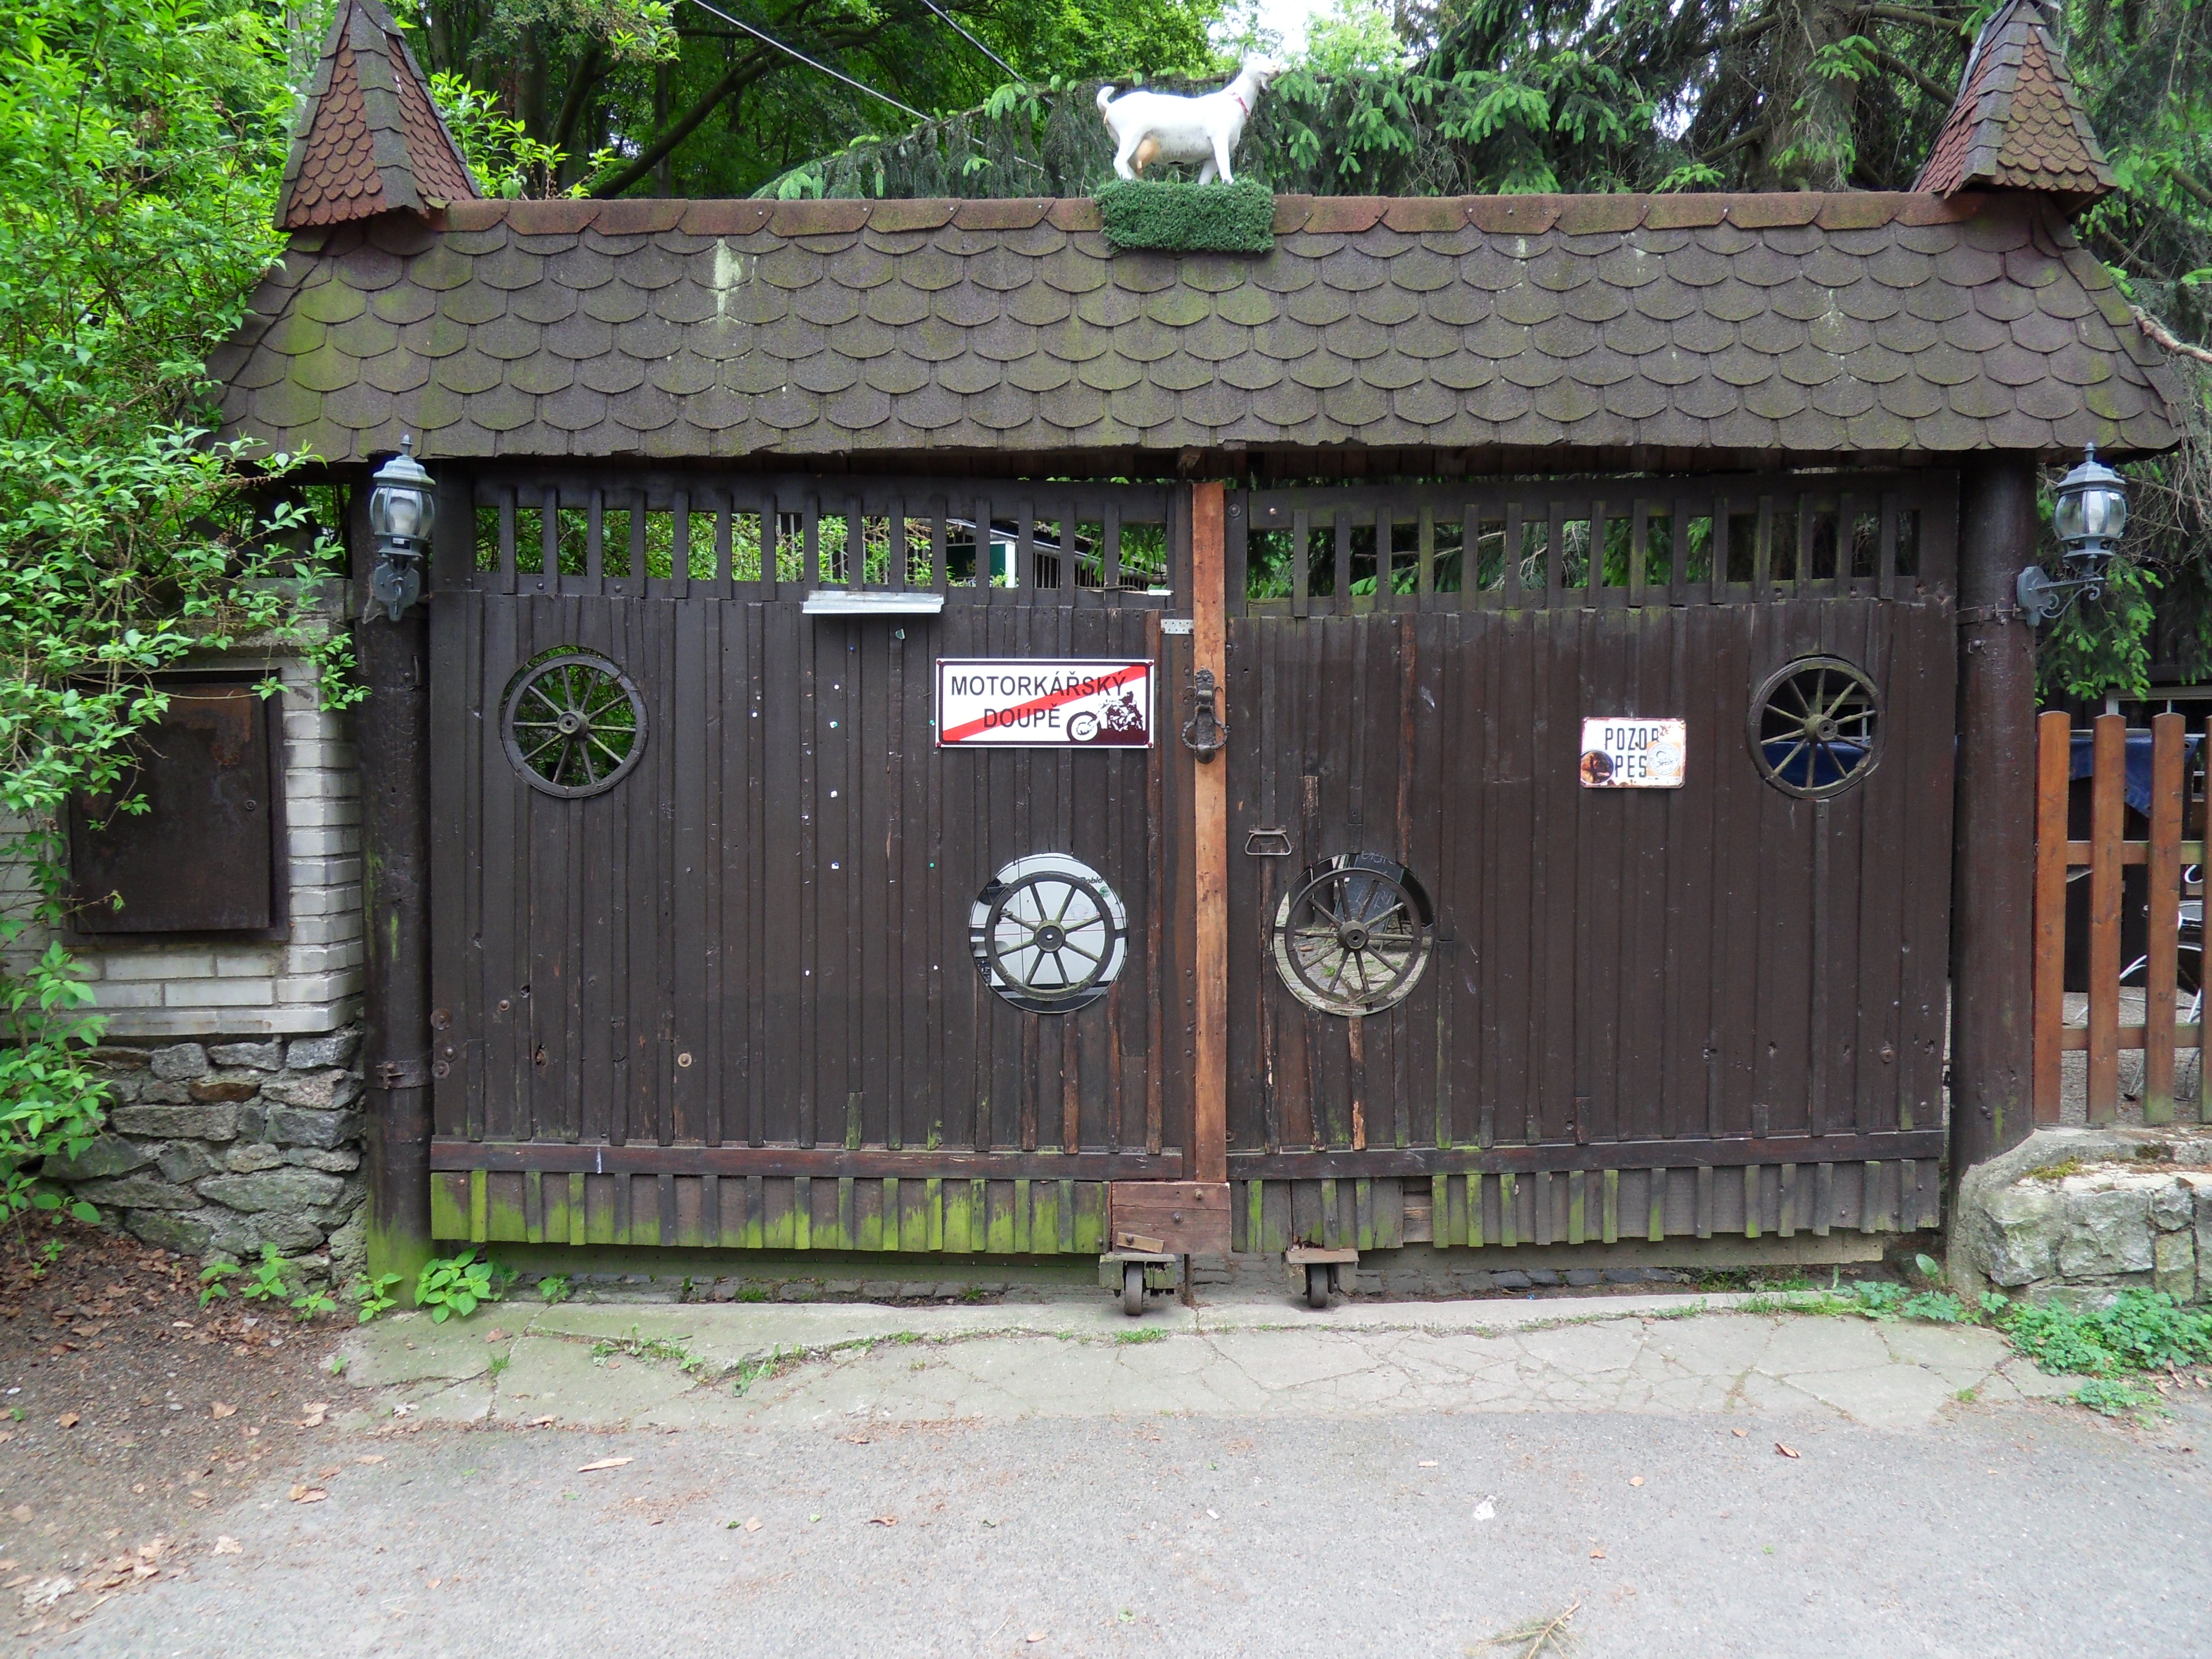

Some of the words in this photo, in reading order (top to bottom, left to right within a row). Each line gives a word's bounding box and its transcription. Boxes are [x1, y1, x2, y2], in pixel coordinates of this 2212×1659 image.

[951, 671, 1126, 696] MOTORKÁŘSKÝ
[984, 703, 1061, 728] DOUPĚ
[1605, 728, 1659, 750] POZOR
[1615, 755, 1647, 778] PES
